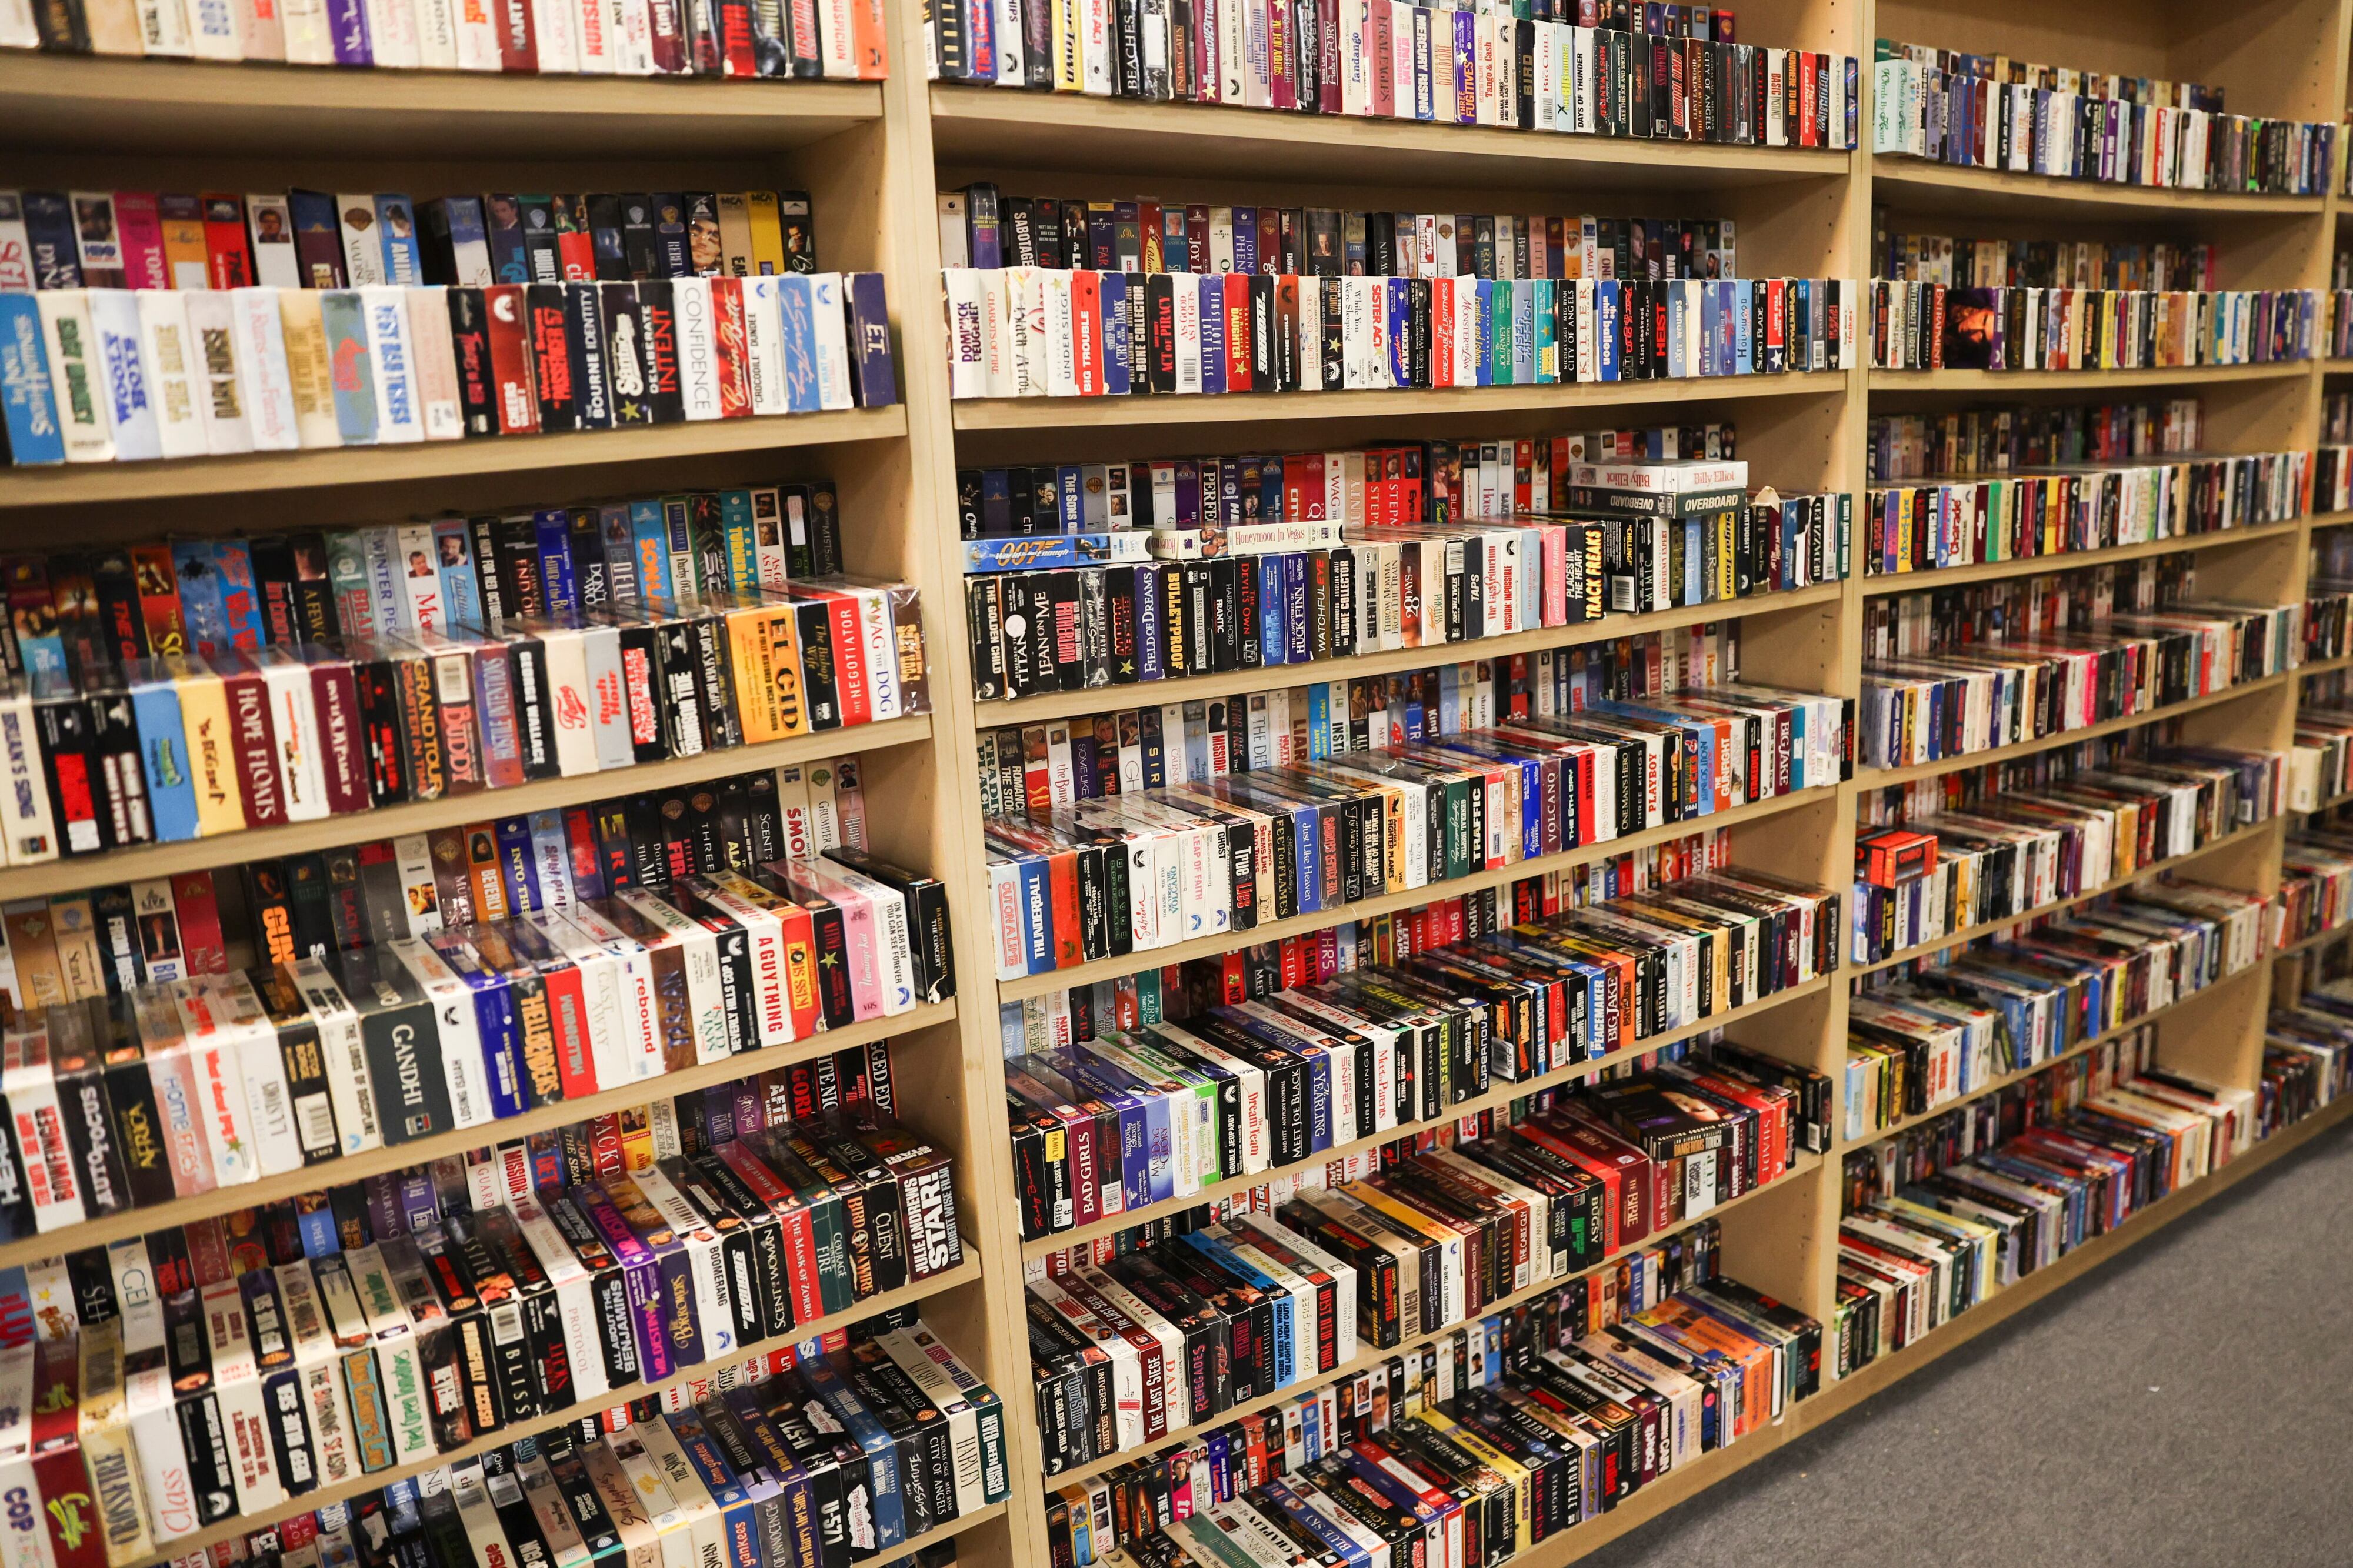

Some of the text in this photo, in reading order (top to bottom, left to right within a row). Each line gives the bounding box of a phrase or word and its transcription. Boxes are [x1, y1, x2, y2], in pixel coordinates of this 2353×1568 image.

[1124, 14, 1138, 89] BEACHES
[1352, 32, 1361, 82] fandango
[1416, 14, 1429, 113] MERCURY RISING
[1438, 44, 1452, 85] DISCLOSURE
[1523, 54, 1532, 95] BIRD
[1464, 61, 1475, 117] FUGITIVES
[1771, 73, 1781, 120] BASIC INSTINCT
[721, 196, 741, 206] MCA
[751, 194, 772, 203] MCA
[1014, 212, 1034, 266] SABOTAGE
[748, 314, 756, 347] DUNDEE
[1081, 311, 1091, 366] TROUBLE
[1159, 295, 1172, 373] ACT PIRACY
[1211, 292, 1221, 351] FIRST LOVE
[1231, 307, 1241, 359] DAUGHTER
[1372, 284, 1382, 347] SISTER ACT
[1656, 302, 1666, 356] HEIST
[1934, 288, 1944, 366] ENTRAPMENT
[580, 290, 605, 419] BOURNE IDENTITY
[641, 305, 659, 394] DELIBERATE
[651, 305, 676, 392] INTENT
[685, 287, 711, 410] CONFIDENCE
[1061, 332, 1070, 379] UNDER
[1611, 495, 1653, 511] OVERBOARD
[1685, 495, 1738, 512] OVERBOARD
[1694, 472, 1734, 486] Billy Elliot
[1235, 528, 1305, 545] Honeymoon In Vegas
[1926, 521, 1938, 559] CHAMBER
[1949, 498, 1961, 555] Charade
[1241, 563, 1251, 635] DEVIL'S OWN
[1340, 560, 1349, 635] BONE COLLECTOR
[1471, 573, 1479, 602] TAPS
[1504, 565, 1512, 630] MISSION: IMPOSSIBLE
[1565, 552, 1574, 598] PLACES IN
[1574, 549, 1583, 599] THE HEART
[1585, 531, 1604, 619] TRACK FREAKS
[1645, 559, 1653, 602] MIMIC
[869, 607, 885, 649] WAG
[986, 583, 1001, 675] THE GOLDEN CHILD
[1142, 572, 1156, 673] FIELD OF DREAMS
[1167, 573, 1184, 669] BULLETPROOF
[770, 618, 798, 729] EL CID
[839, 609, 861, 699] NEGOTIATOR
[519, 650, 545, 764] GEORGE WALLACE
[675, 671, 694, 699] TIDE
[876, 671, 893, 712] DOG
[237, 688, 276, 819] HOPE FLOATS
[442, 704, 472, 782] BUDDY
[678, 699, 703, 755] CRIMSON
[1648, 753, 1657, 813] PLAYBOY
[1721, 738, 1730, 797] GUNFIGHT
[1749, 749, 1759, 798] STAKEOUT
[1304, 846, 1312, 864] Like
[1472, 787, 1481, 863] TRAFFIC
[1235, 846, 1253, 909] True Lies
[1029, 874, 1045, 959] THUNDERBALL
[1134, 883, 1151, 940] Sabrina
[892, 950, 902, 984] FOREVER
[932, 935, 941, 968] CONCERT
[939, 931, 947, 976] STREISAND
[636, 978, 655, 1053] rebound
[722, 965, 742, 1052] BEVERLY HILLS COP
[759, 937, 783, 1033] A GUY THING
[1594, 980, 1605, 1051] PEACEMAKER
[559, 994, 584, 1075] MILLENNIUM
[1439, 1023, 1448, 1084] STRIPES
[1479, 1011, 1488, 1090] SUPERNOVA
[1537, 999, 1546, 1062] BOILER ROOM
[392, 1024, 423, 1106] GANDHI
[1291, 1069, 1302, 1158] MEET JOE BLACK
[1313, 1070, 1326, 1137] YEARLING
[1078, 1132, 1094, 1214] BAD GIRLS
[875, 1212, 893, 1260] CLIENT
[904, 1177, 929, 1274] JULIE ANDREWS
[918, 1172, 949, 1270] STAR!
[939, 1166, 959, 1255] ROBERT WISE FILM
[710, 1246, 729, 1307] BOOMERANG
[816, 1246, 832, 1275] FIRE
[833, 1232, 847, 1279] COURAGE
[610, 1280, 636, 1373] BENJAMINS
[801, 1282, 812, 1319] ZORRO
[568, 1307, 588, 1375] PROTOCOL
[1146, 1355, 1161, 1388] SIEGE
[1166, 1359, 1176, 1412] DAVE
[1193, 1343, 1209, 1412] RENEGADES
[1098, 1368, 1111, 1450] UNIVERSAL SOLDIER
[930, 1437, 946, 1516] CITY OF ANGELS
[956, 1436, 981, 1489] HARVEY
[162, 1468, 195, 1533] Class
[821, 1500, 844, 1546] U-571
